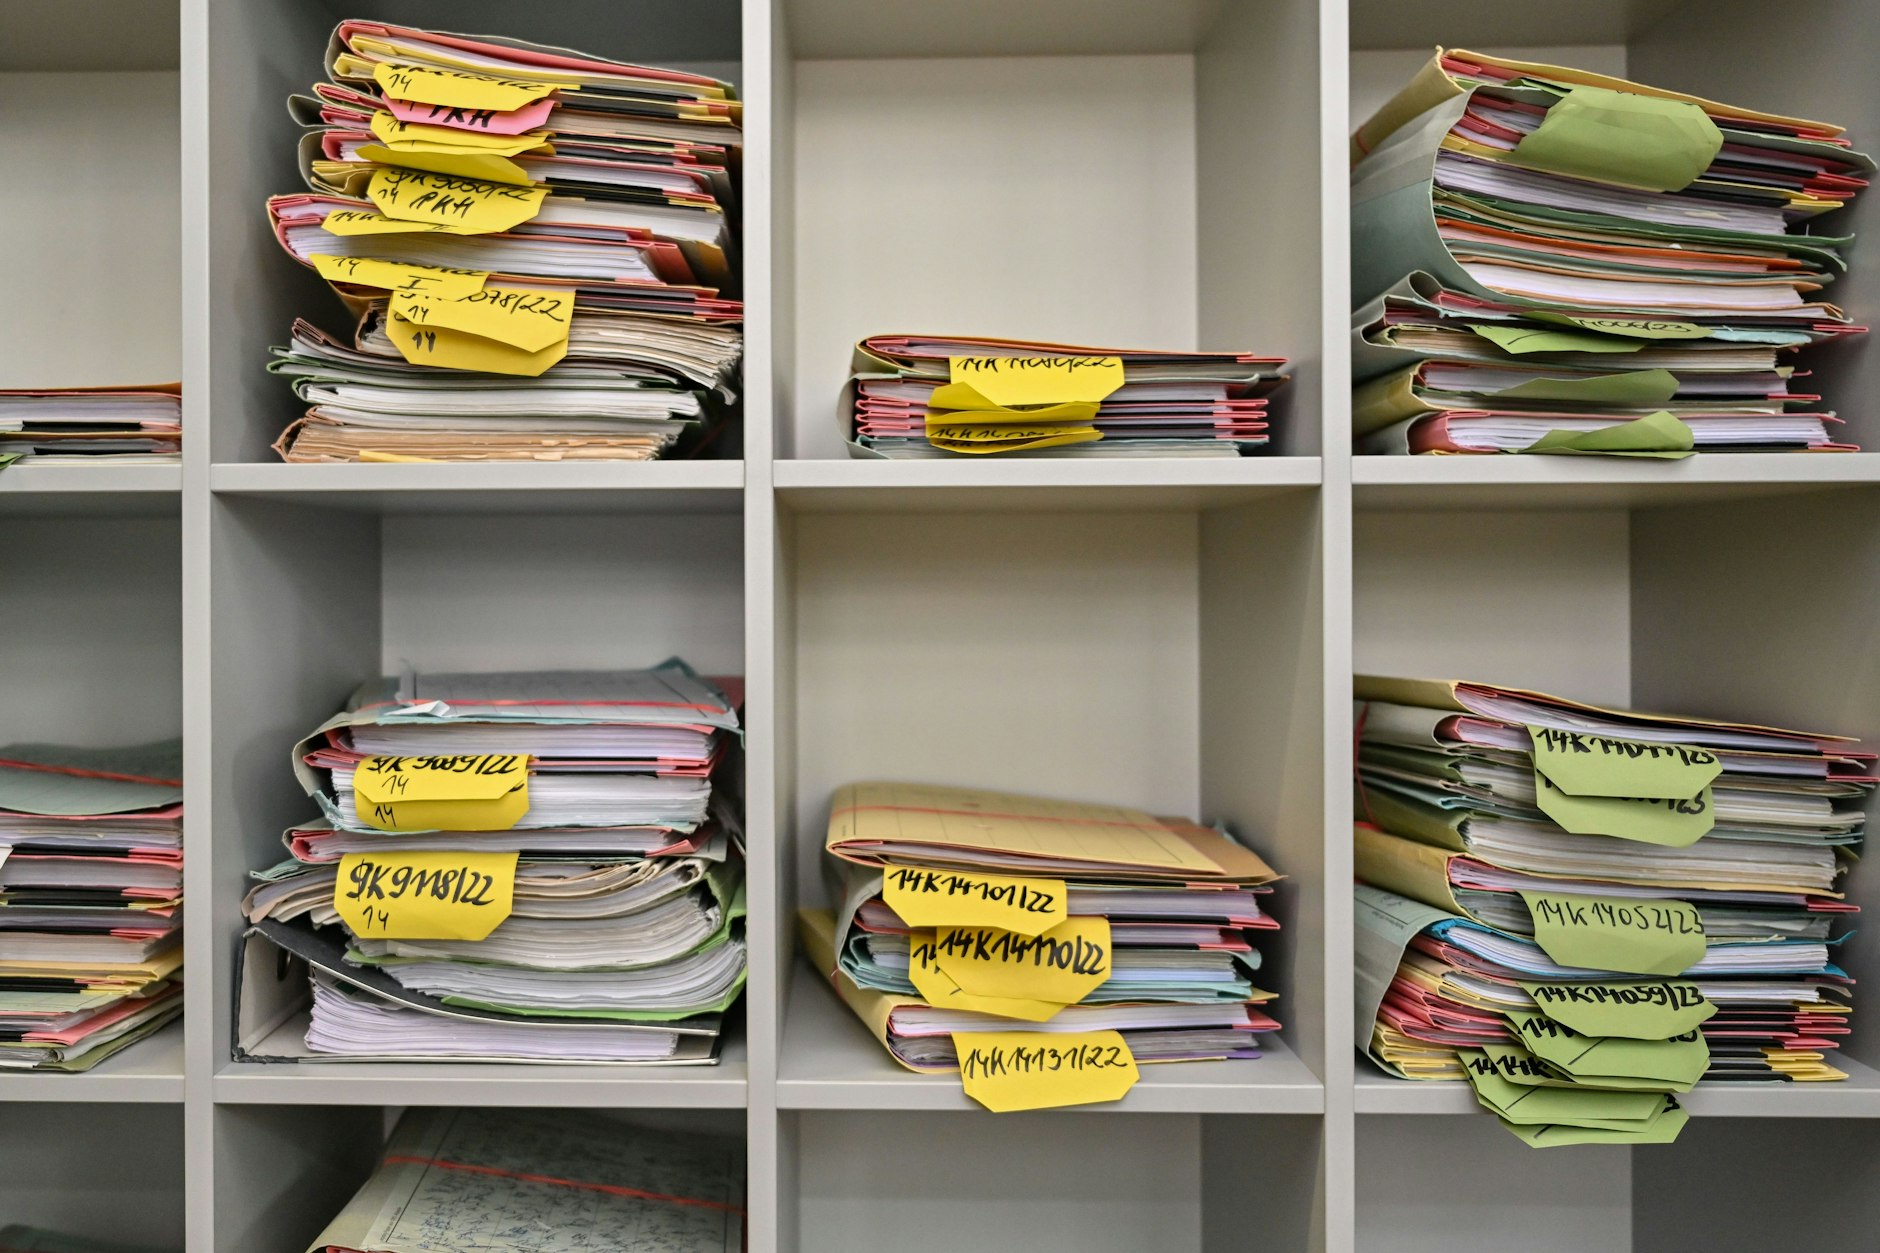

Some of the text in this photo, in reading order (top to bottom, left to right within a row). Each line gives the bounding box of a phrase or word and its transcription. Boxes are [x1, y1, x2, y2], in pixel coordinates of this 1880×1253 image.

[389, 73, 412, 93] 14
[378, 187, 398, 205] 14
[409, 192, 475, 219] PKH
[333, 257, 359, 276] 14
[408, 305, 430, 323] 14
[412, 331, 436, 353] 14
[382, 774, 409, 796] 14
[374, 804, 397, 827] 14
[363, 905, 389, 932] 14
